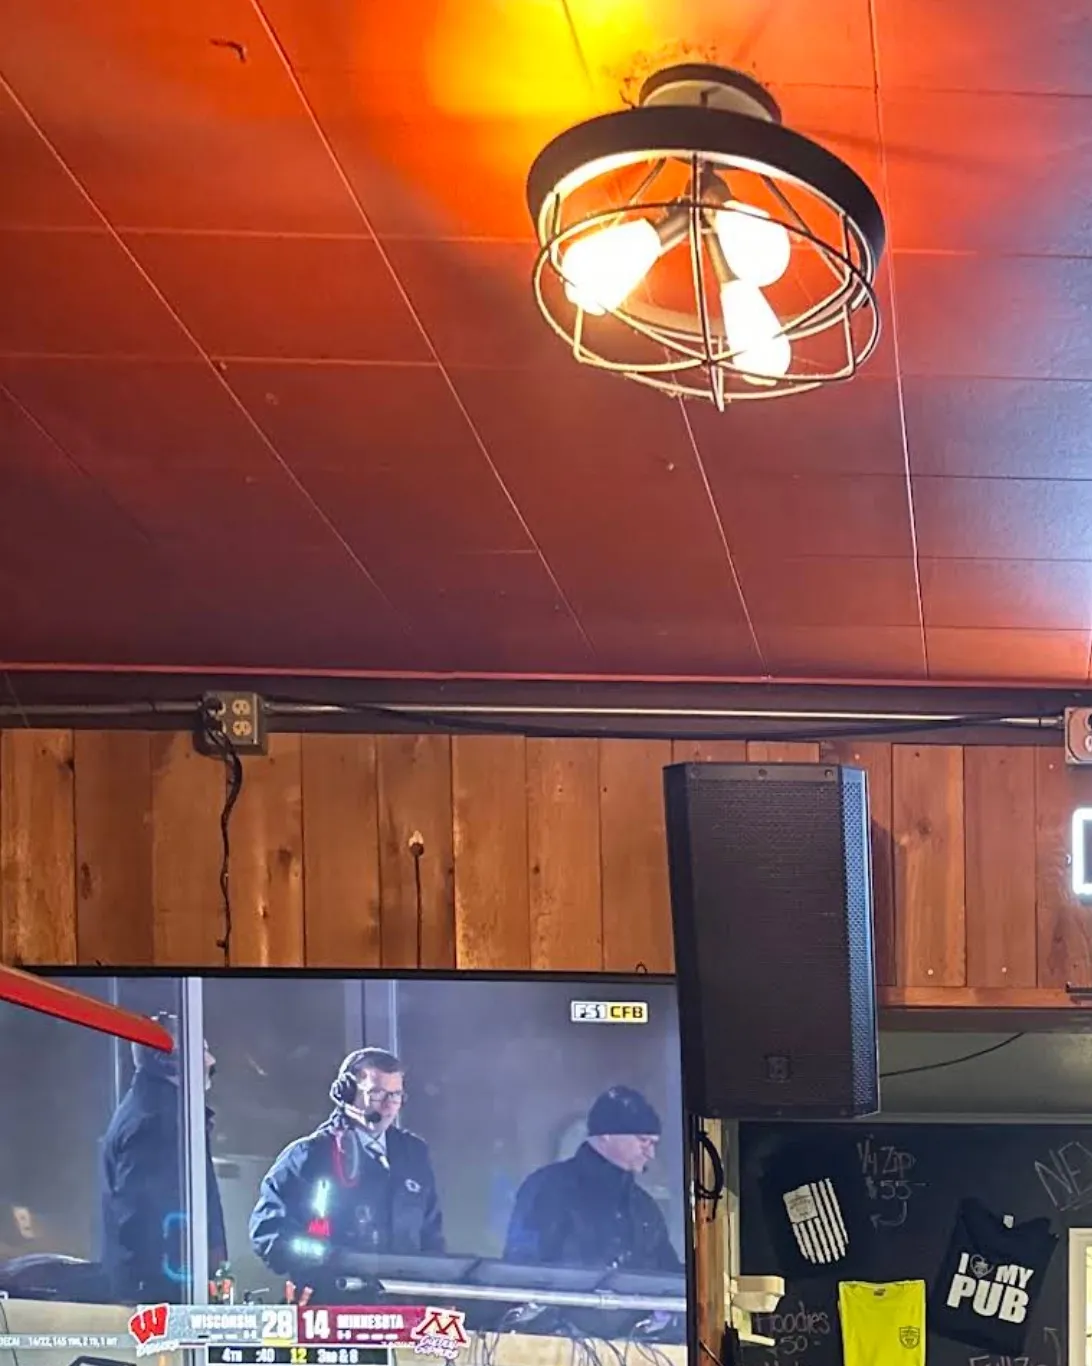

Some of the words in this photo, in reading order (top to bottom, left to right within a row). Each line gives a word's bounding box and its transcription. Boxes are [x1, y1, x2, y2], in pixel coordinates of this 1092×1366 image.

[574, 1003, 608, 1019] FS1
[610, 1005, 644, 1019] CFB
[957, 1252, 970, 1275] I
[995, 1264, 1035, 1290] MY
[946, 1273, 1030, 1324] PUB
[191, 1313, 257, 1329] WISCONSIN
[261, 1309, 293, 1338] 28
[301, 1309, 331, 1340] 14
[336, 1314, 405, 1330] MINNESOTA
